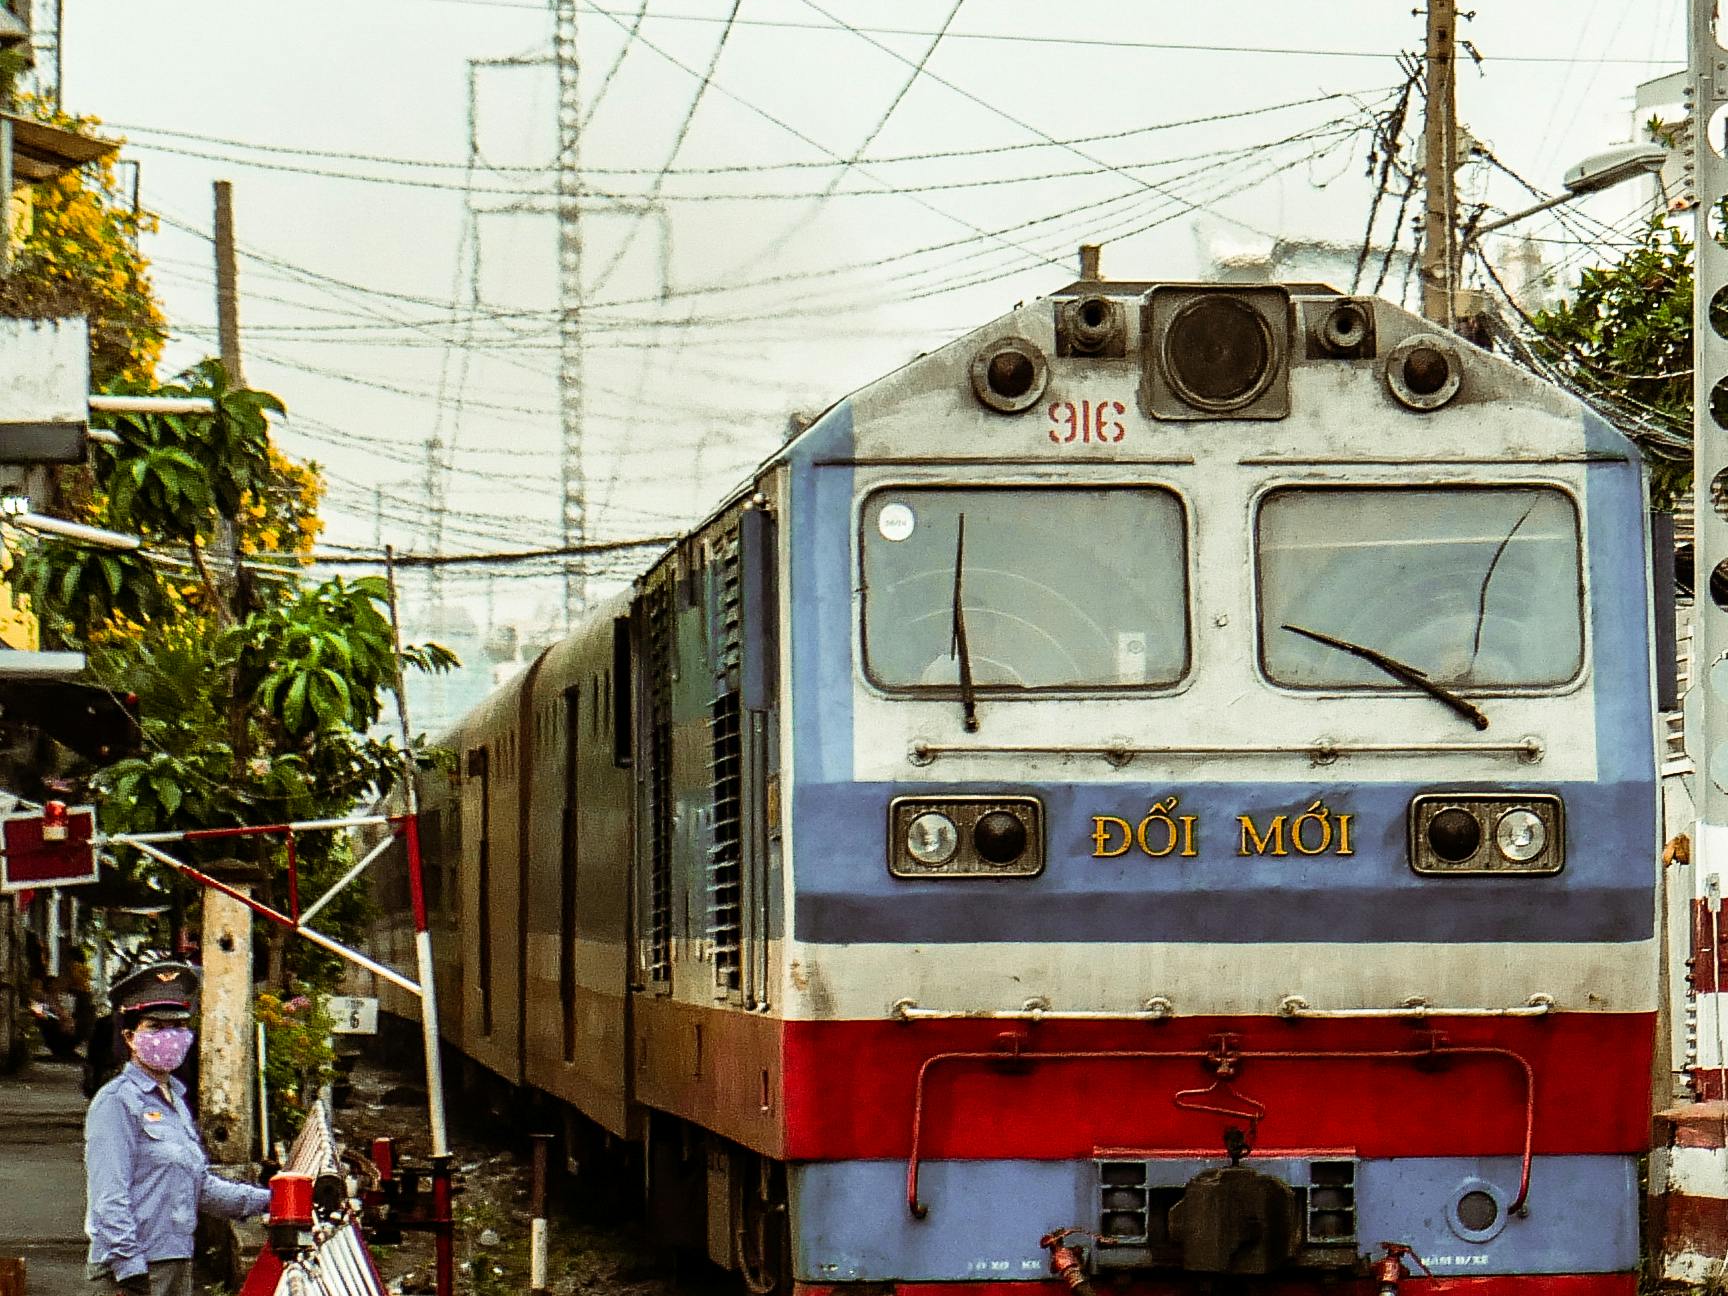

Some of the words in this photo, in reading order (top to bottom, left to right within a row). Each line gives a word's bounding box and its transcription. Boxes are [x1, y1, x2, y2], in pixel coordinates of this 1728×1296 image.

[1048, 400, 1125, 443] 916
[1091, 796, 1198, 857] ĐỔI
[1236, 800, 1354, 856] MỚI
